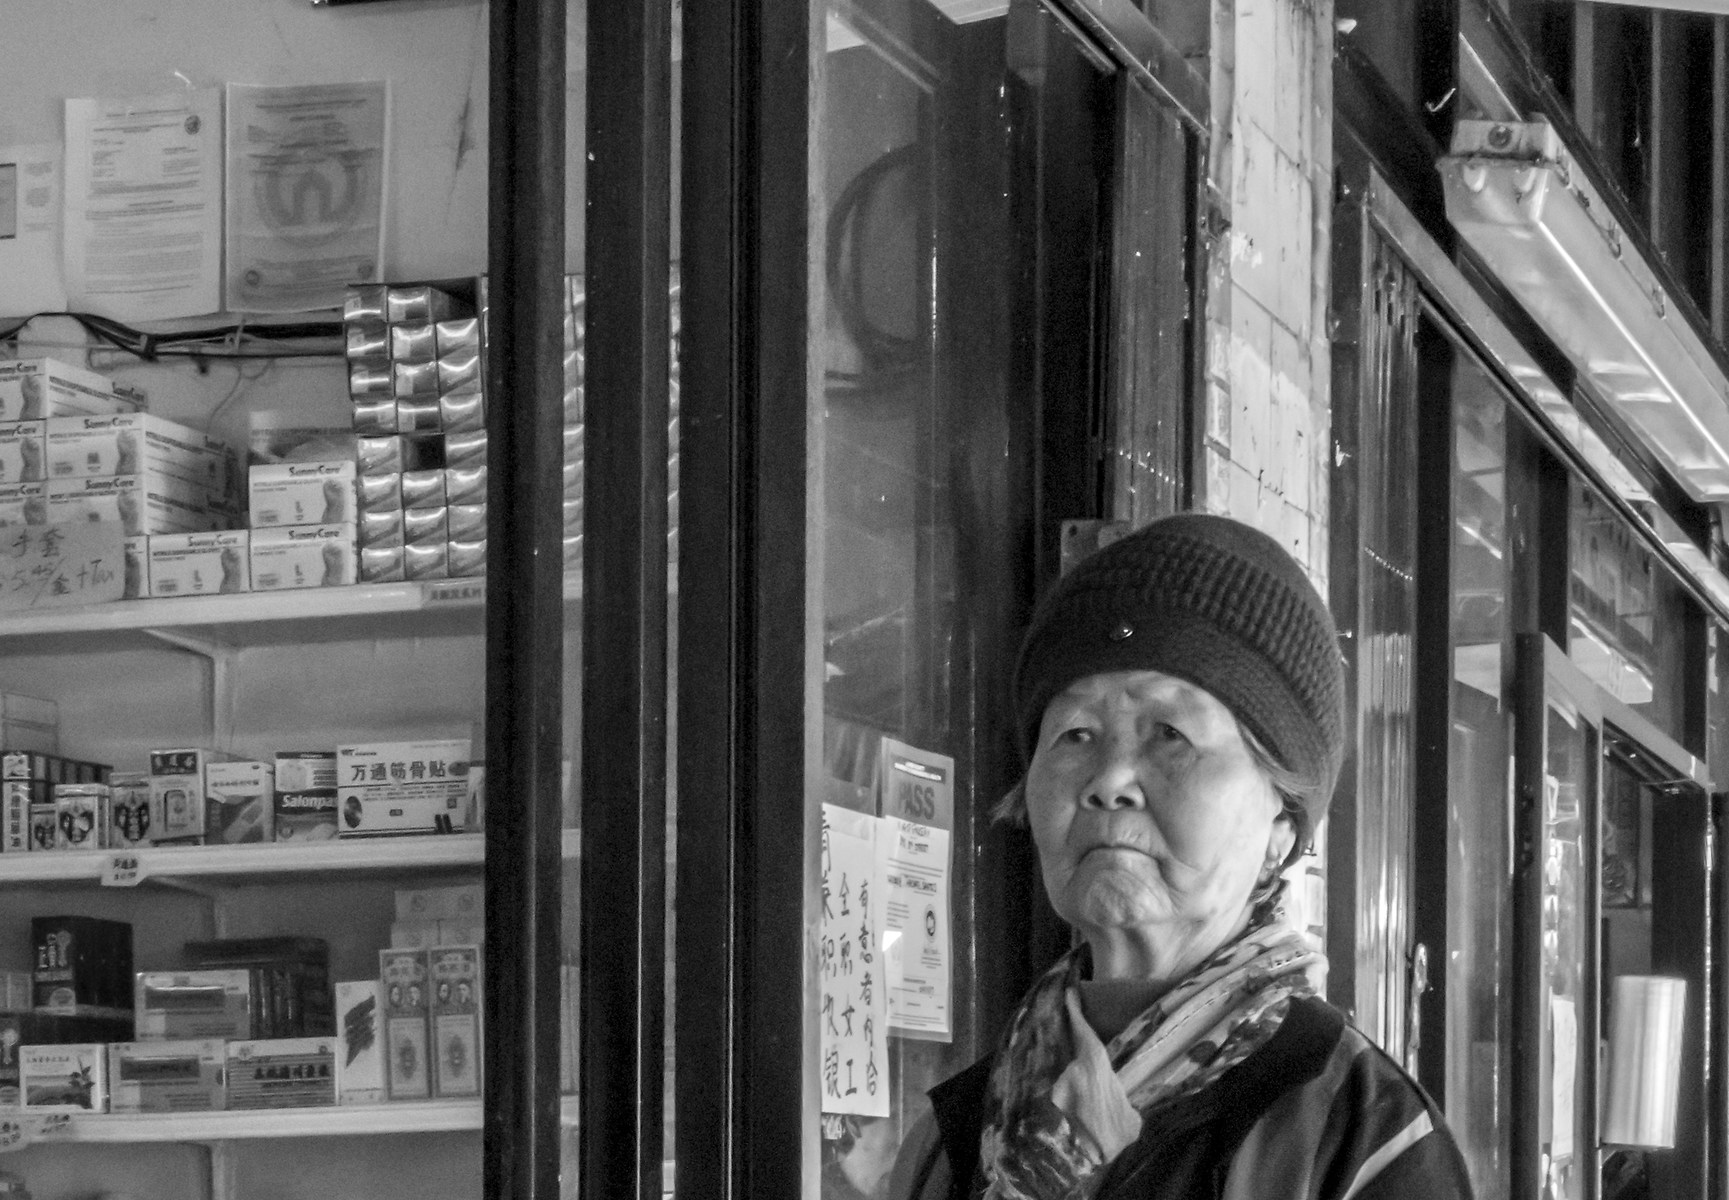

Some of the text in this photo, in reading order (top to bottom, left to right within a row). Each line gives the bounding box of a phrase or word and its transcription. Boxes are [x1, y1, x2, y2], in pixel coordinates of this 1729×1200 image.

[289, 464, 341, 477] SunnyCare
[188, 534, 238, 547] SunnyCare
[289, 528, 340, 540] SunnyCare
[351, 761, 446, 781] 万通筋骨贴
[282, 795, 338, 810] Salonpa
